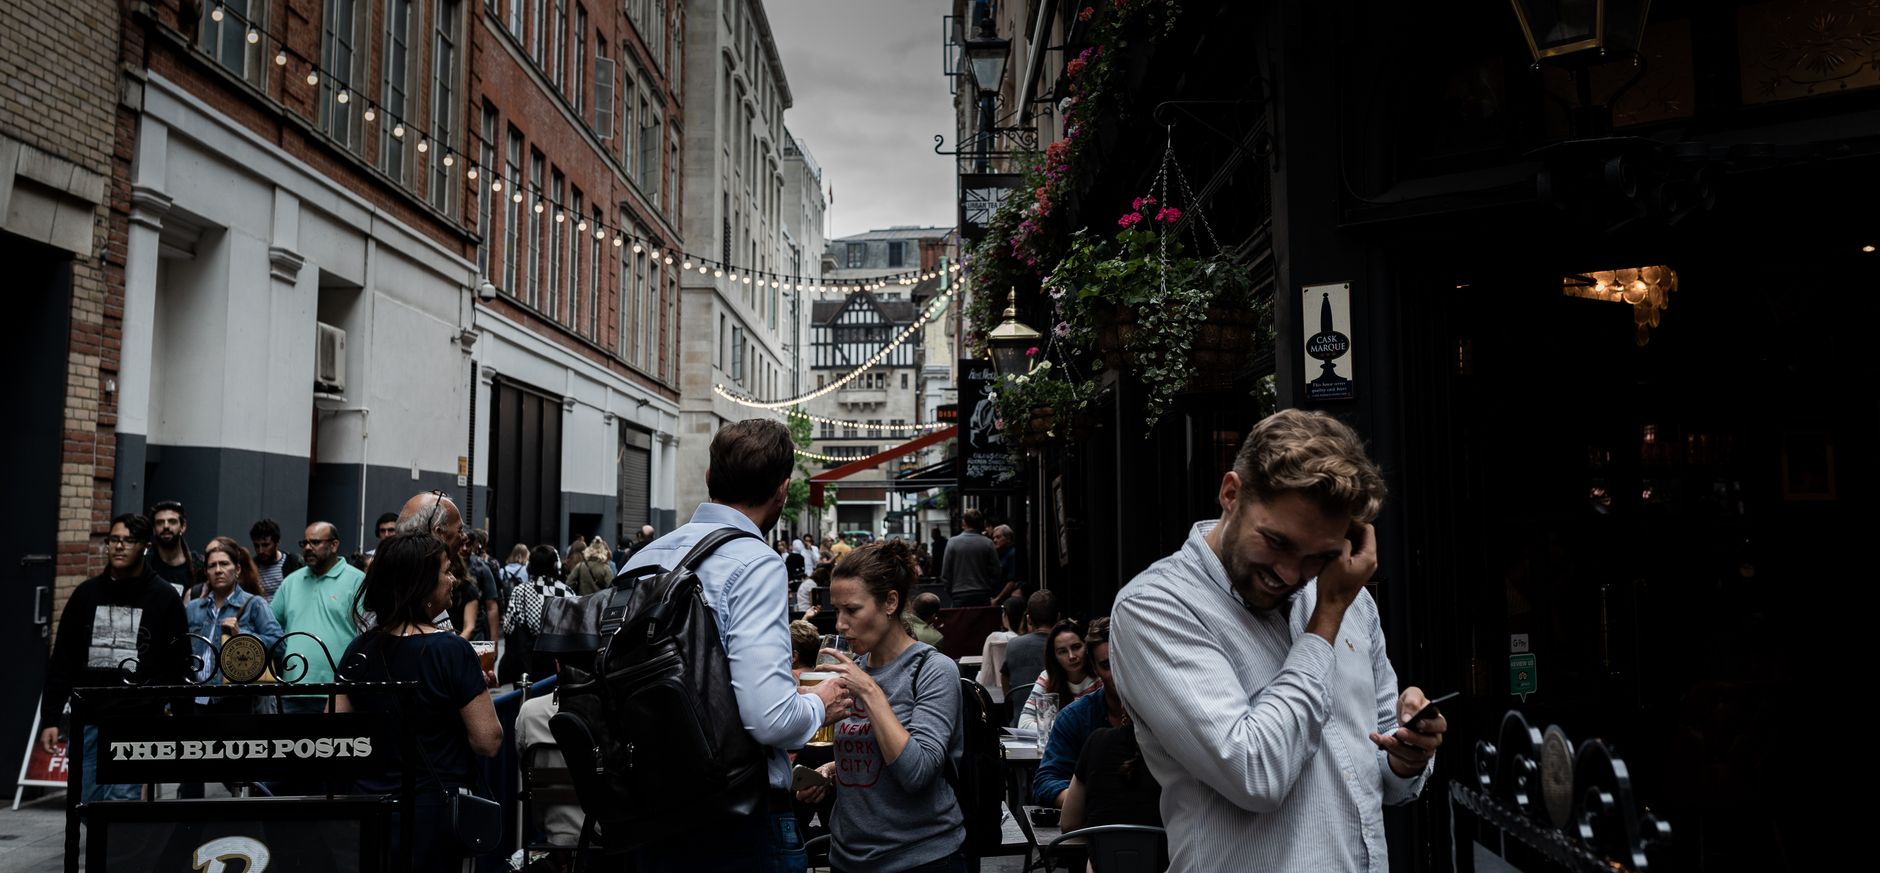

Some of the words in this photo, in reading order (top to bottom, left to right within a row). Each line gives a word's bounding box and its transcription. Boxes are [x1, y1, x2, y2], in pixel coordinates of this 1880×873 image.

[1316, 335, 1338, 344] CASK
[1310, 342, 1346, 352] MARQUE
[839, 722, 871, 736] NEW
[110, 741, 176, 760] THE
[180, 739, 268, 760] BLUE
[272, 737, 372, 759] POSTS
[834, 740, 874, 754] YORK
[841, 759, 872, 773] CITY
